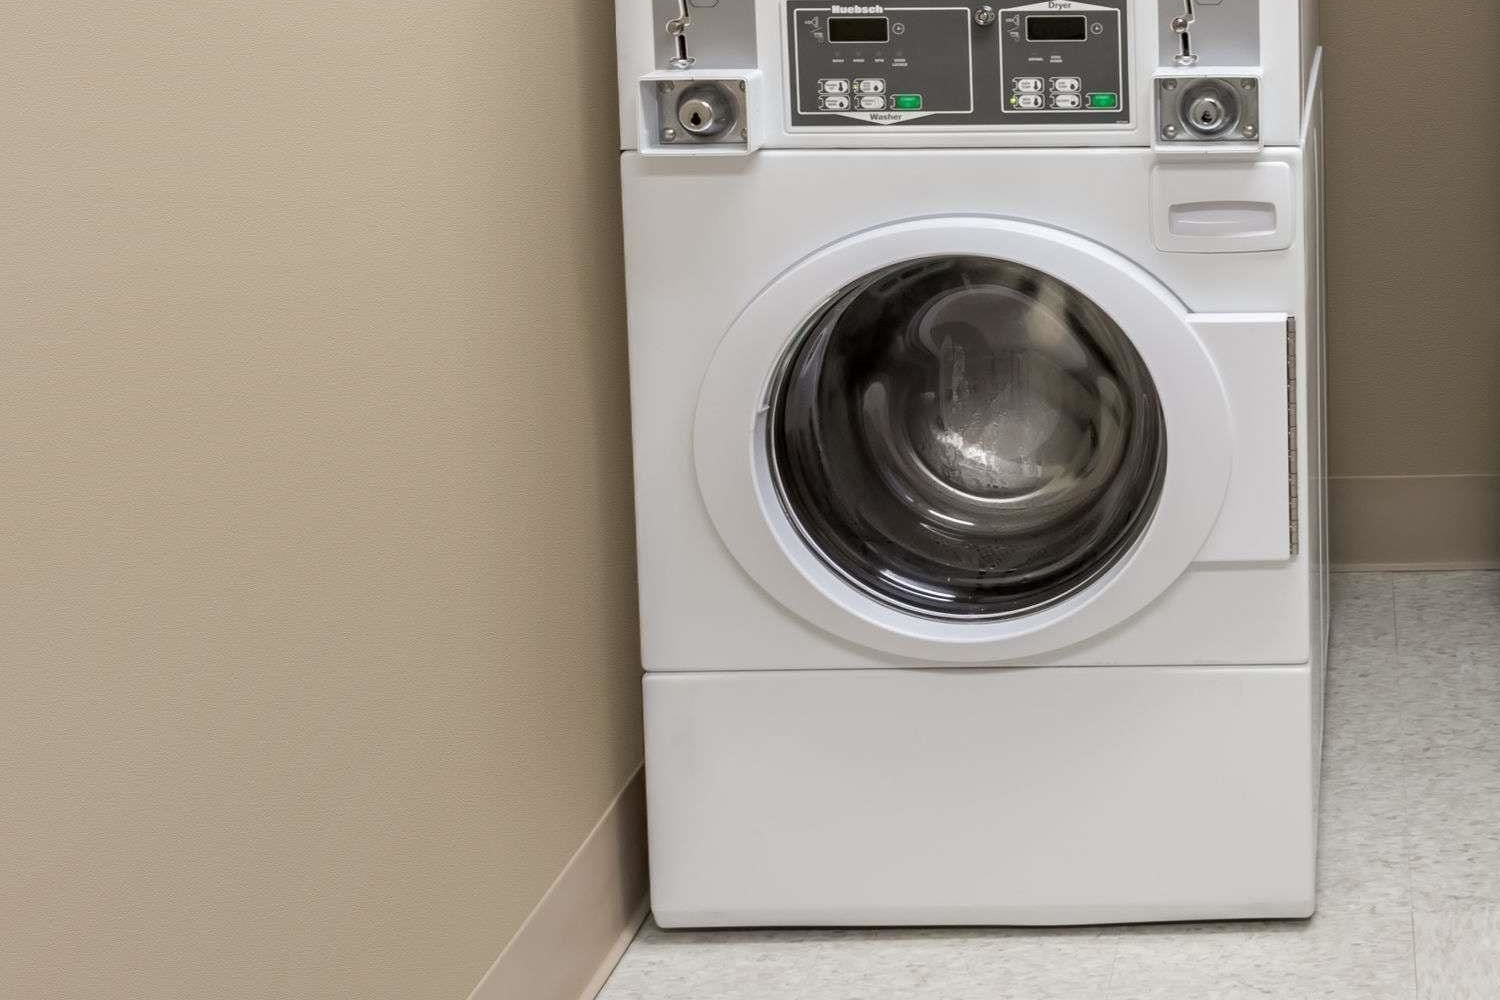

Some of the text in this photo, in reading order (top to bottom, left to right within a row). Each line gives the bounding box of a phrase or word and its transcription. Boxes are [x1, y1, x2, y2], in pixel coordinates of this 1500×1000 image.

[1049, 0, 1071, 9] Dryer
[832, 5, 883, 13] Huebsch
[870, 112, 902, 120] Washer
